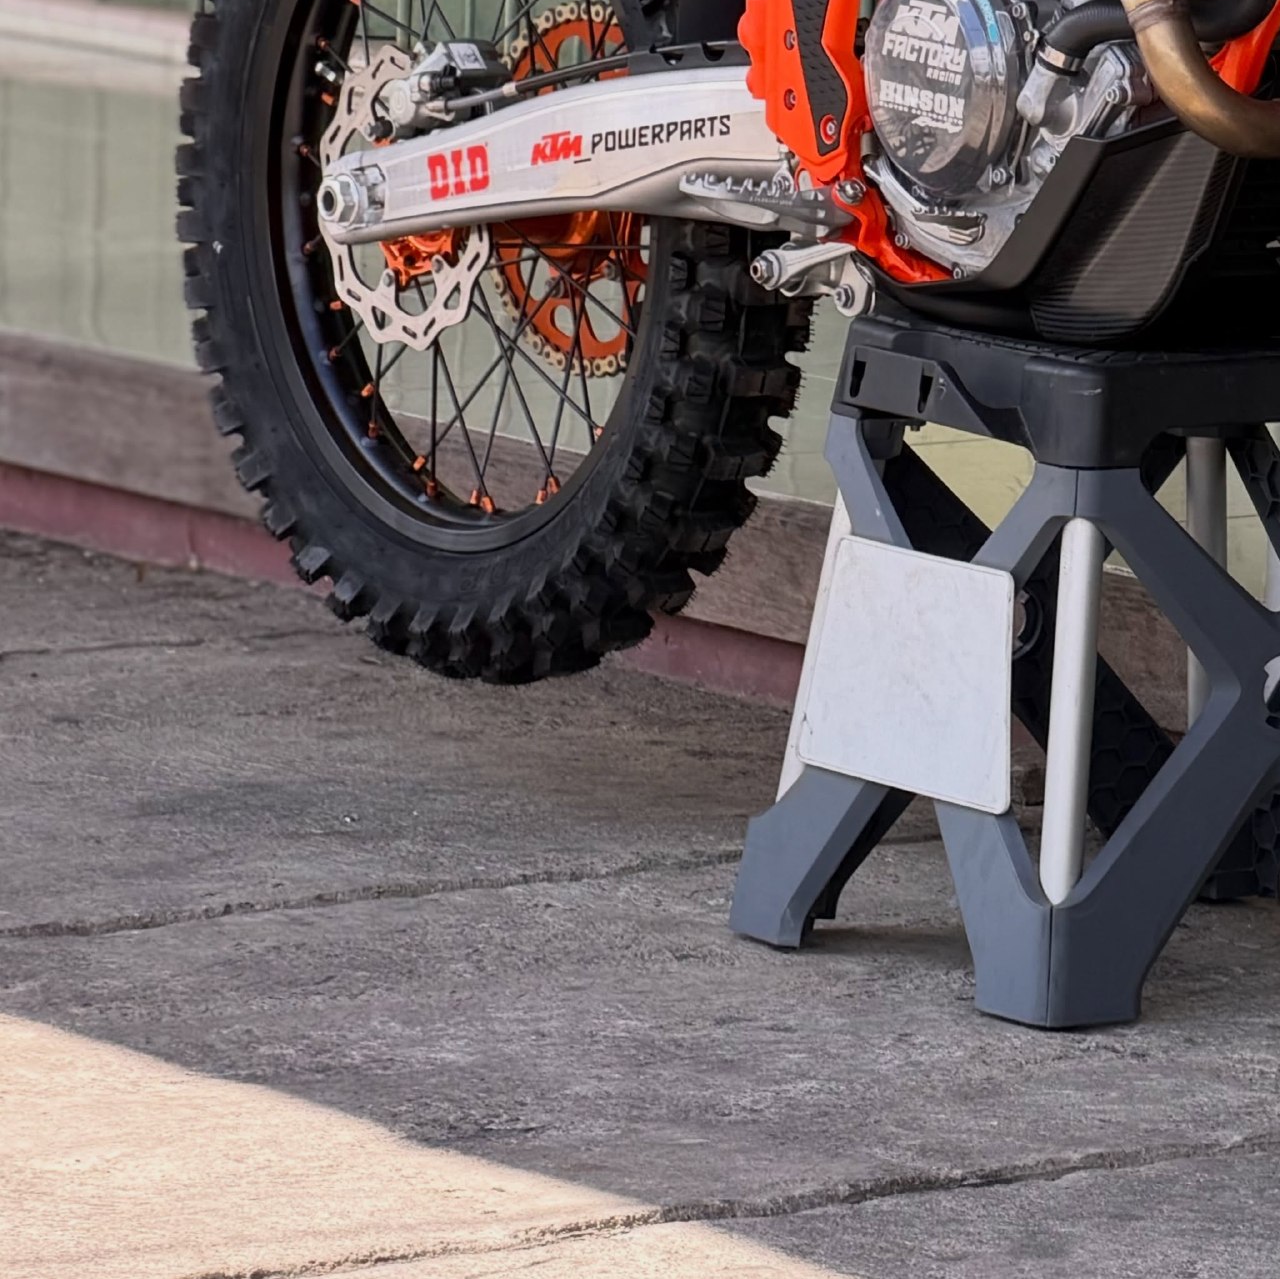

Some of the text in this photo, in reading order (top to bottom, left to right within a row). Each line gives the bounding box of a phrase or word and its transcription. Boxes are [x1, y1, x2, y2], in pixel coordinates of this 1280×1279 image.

[892, 0, 960, 45] KTM
[882, 32, 967, 74] FACTORY
[879, 79, 965, 118] HINSON
